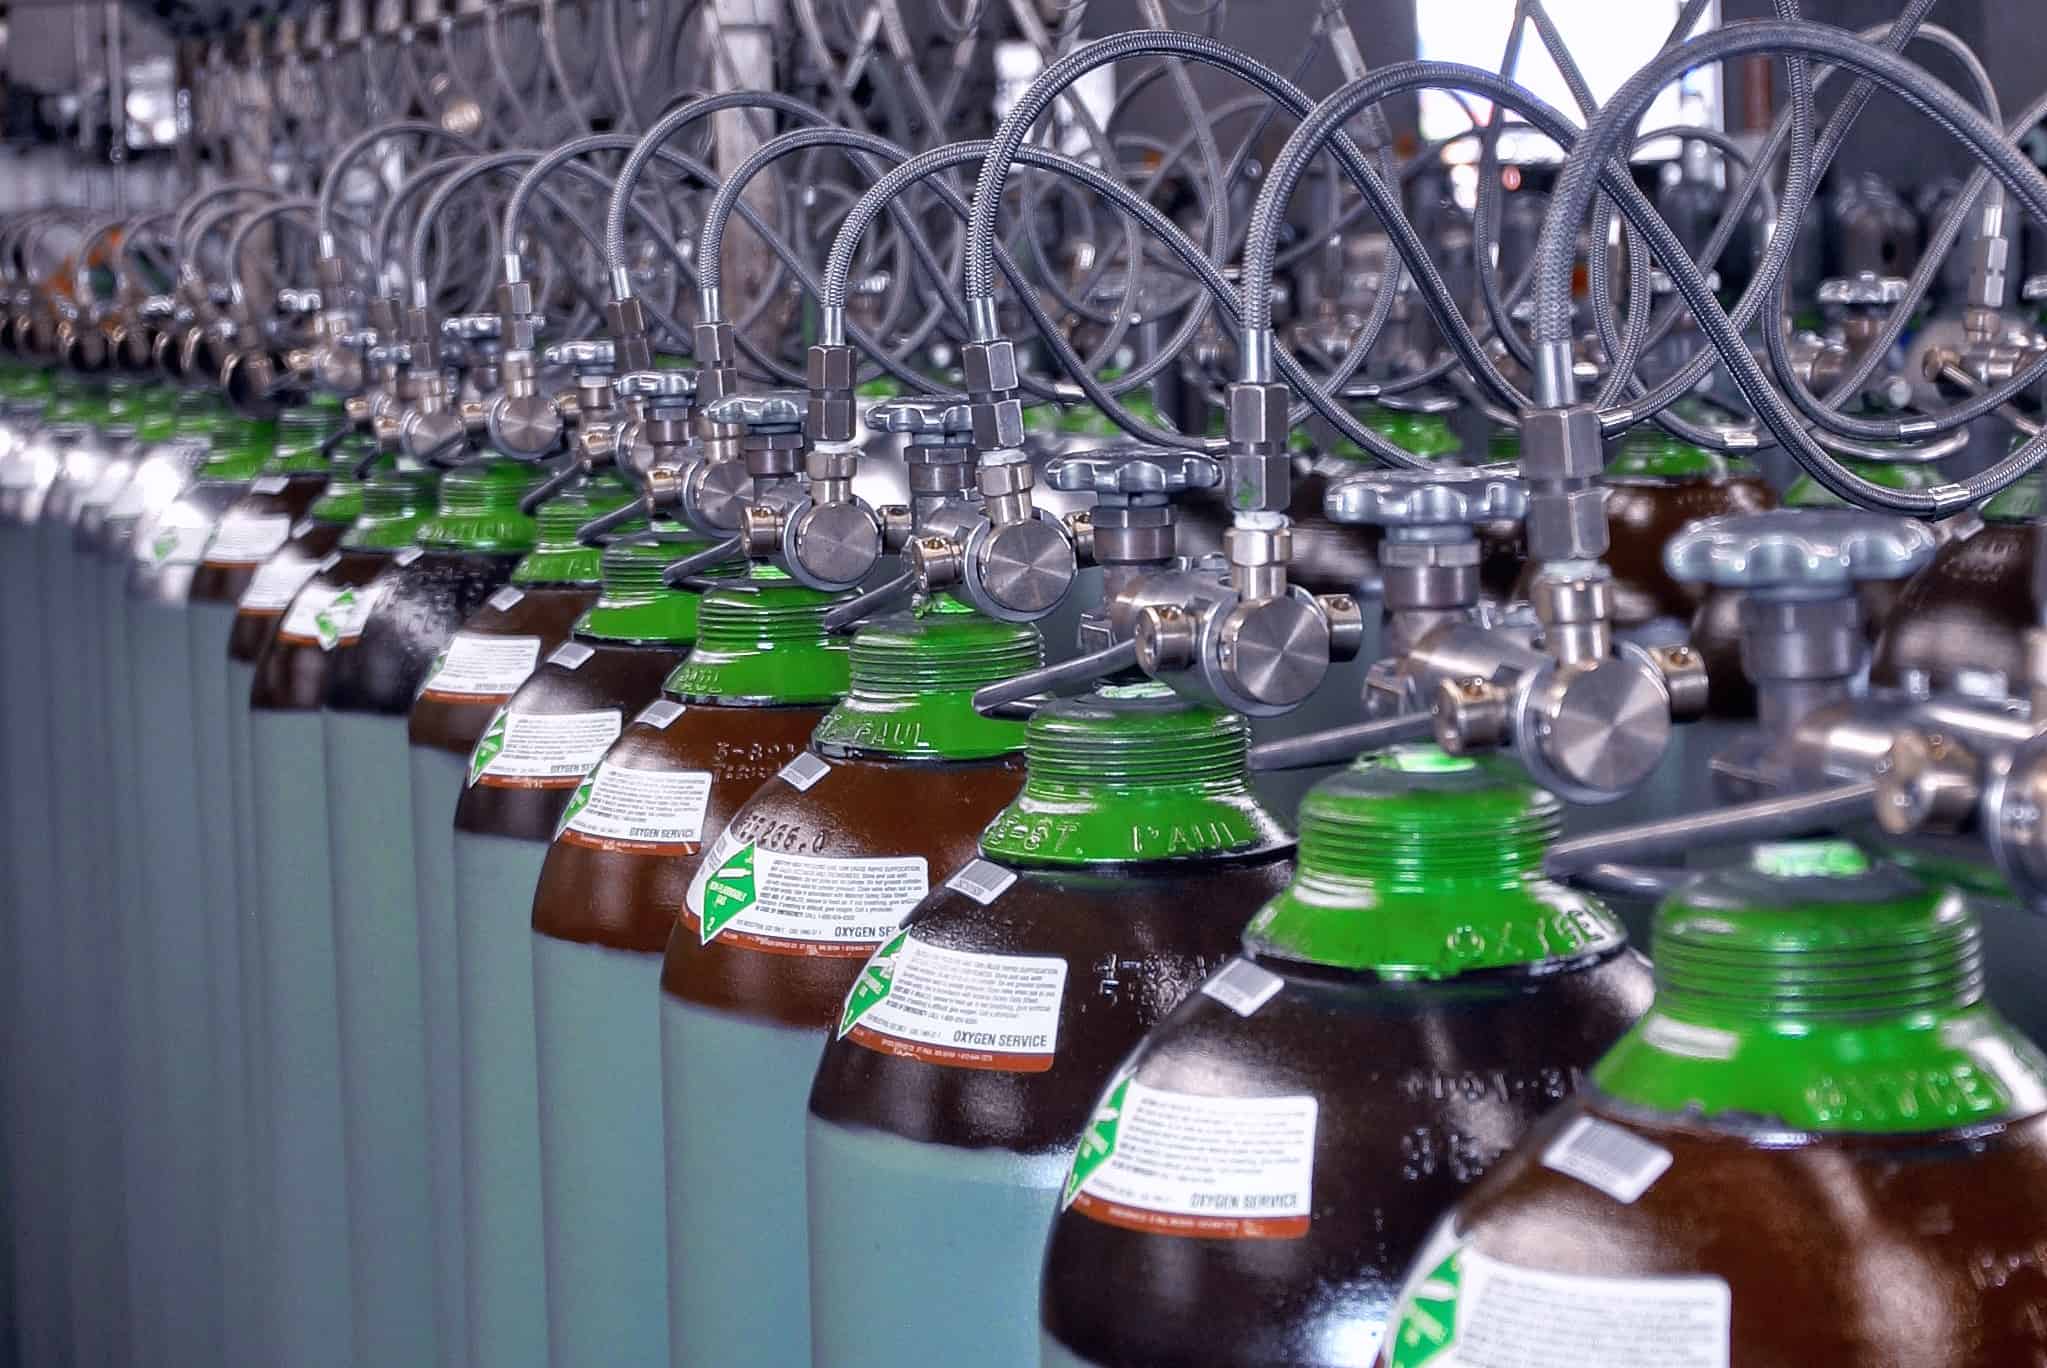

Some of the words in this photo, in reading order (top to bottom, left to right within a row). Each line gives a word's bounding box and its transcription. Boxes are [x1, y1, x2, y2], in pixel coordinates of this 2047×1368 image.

[834, 926, 876, 938] OXYGEN
[878, 925, 897, 937] SE
[953, 1030, 996, 1046] OXYGEN
[998, 1031, 1048, 1047] SERVICE
